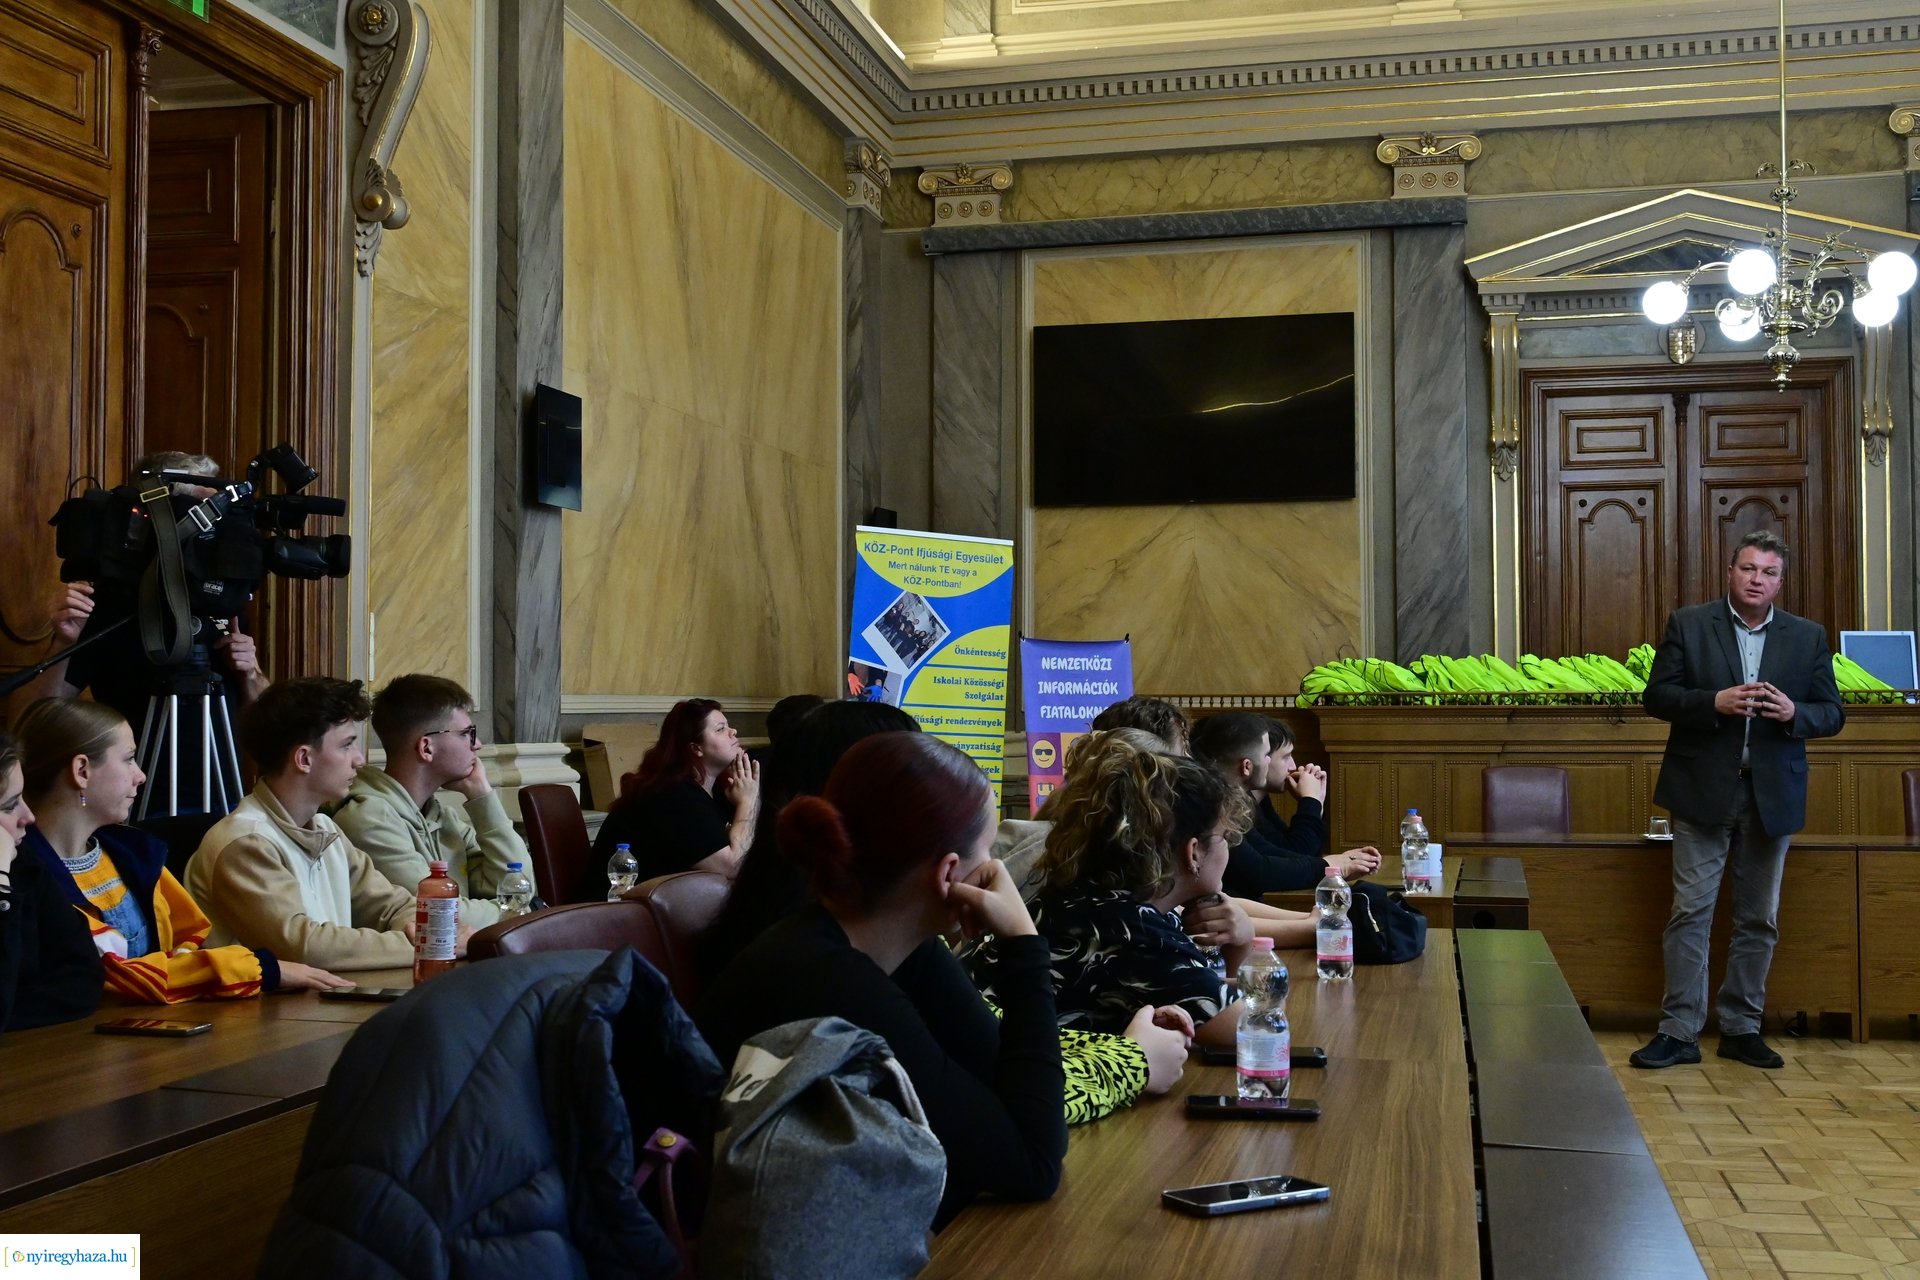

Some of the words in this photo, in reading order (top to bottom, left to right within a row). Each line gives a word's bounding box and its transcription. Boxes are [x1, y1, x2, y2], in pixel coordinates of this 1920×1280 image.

[864, 541, 913, 556] KÖZ-Pont
[916, 547, 953, 562] Ifjúsági
[955, 551, 1004, 565] Egyesület
[888, 560, 907, 570] Mert
[909, 562, 937, 573] nálunk
[939, 565, 950, 574] TE
[952, 568, 970, 577] vagy
[903, 576, 962, 588] KÖZ-Pontban!
[954, 645, 1006, 659] Önkéntesség
[1041, 655, 1112, 671] NEMZETKÖZI
[933, 676, 962, 685] Iskolai
[964, 677, 1005, 689] Közösségi
[1038, 679, 1118, 695] INFORMÁCIÓK
[964, 691, 1004, 702] Szolgálat
[945, 717, 1002, 729] rendezvények
